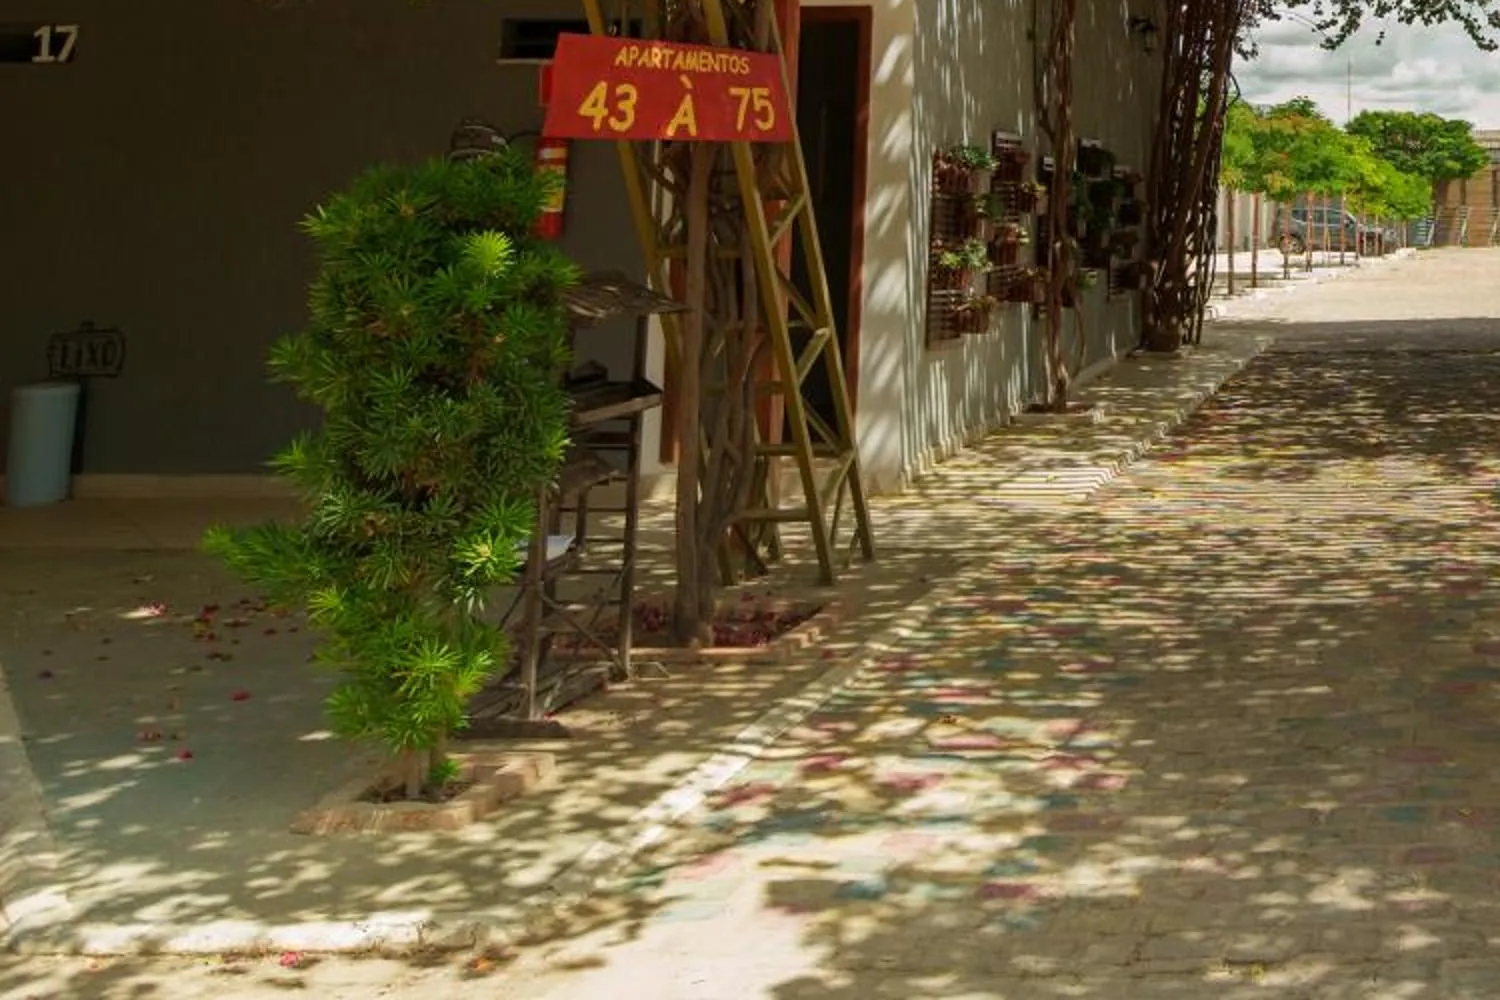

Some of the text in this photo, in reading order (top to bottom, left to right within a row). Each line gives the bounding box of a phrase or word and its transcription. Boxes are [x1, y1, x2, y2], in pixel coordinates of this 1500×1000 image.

[32, 24, 80, 63] 17
[614, 46, 750, 74] APARTAMENTOS
[577, 74, 776, 137] 43 À 75
